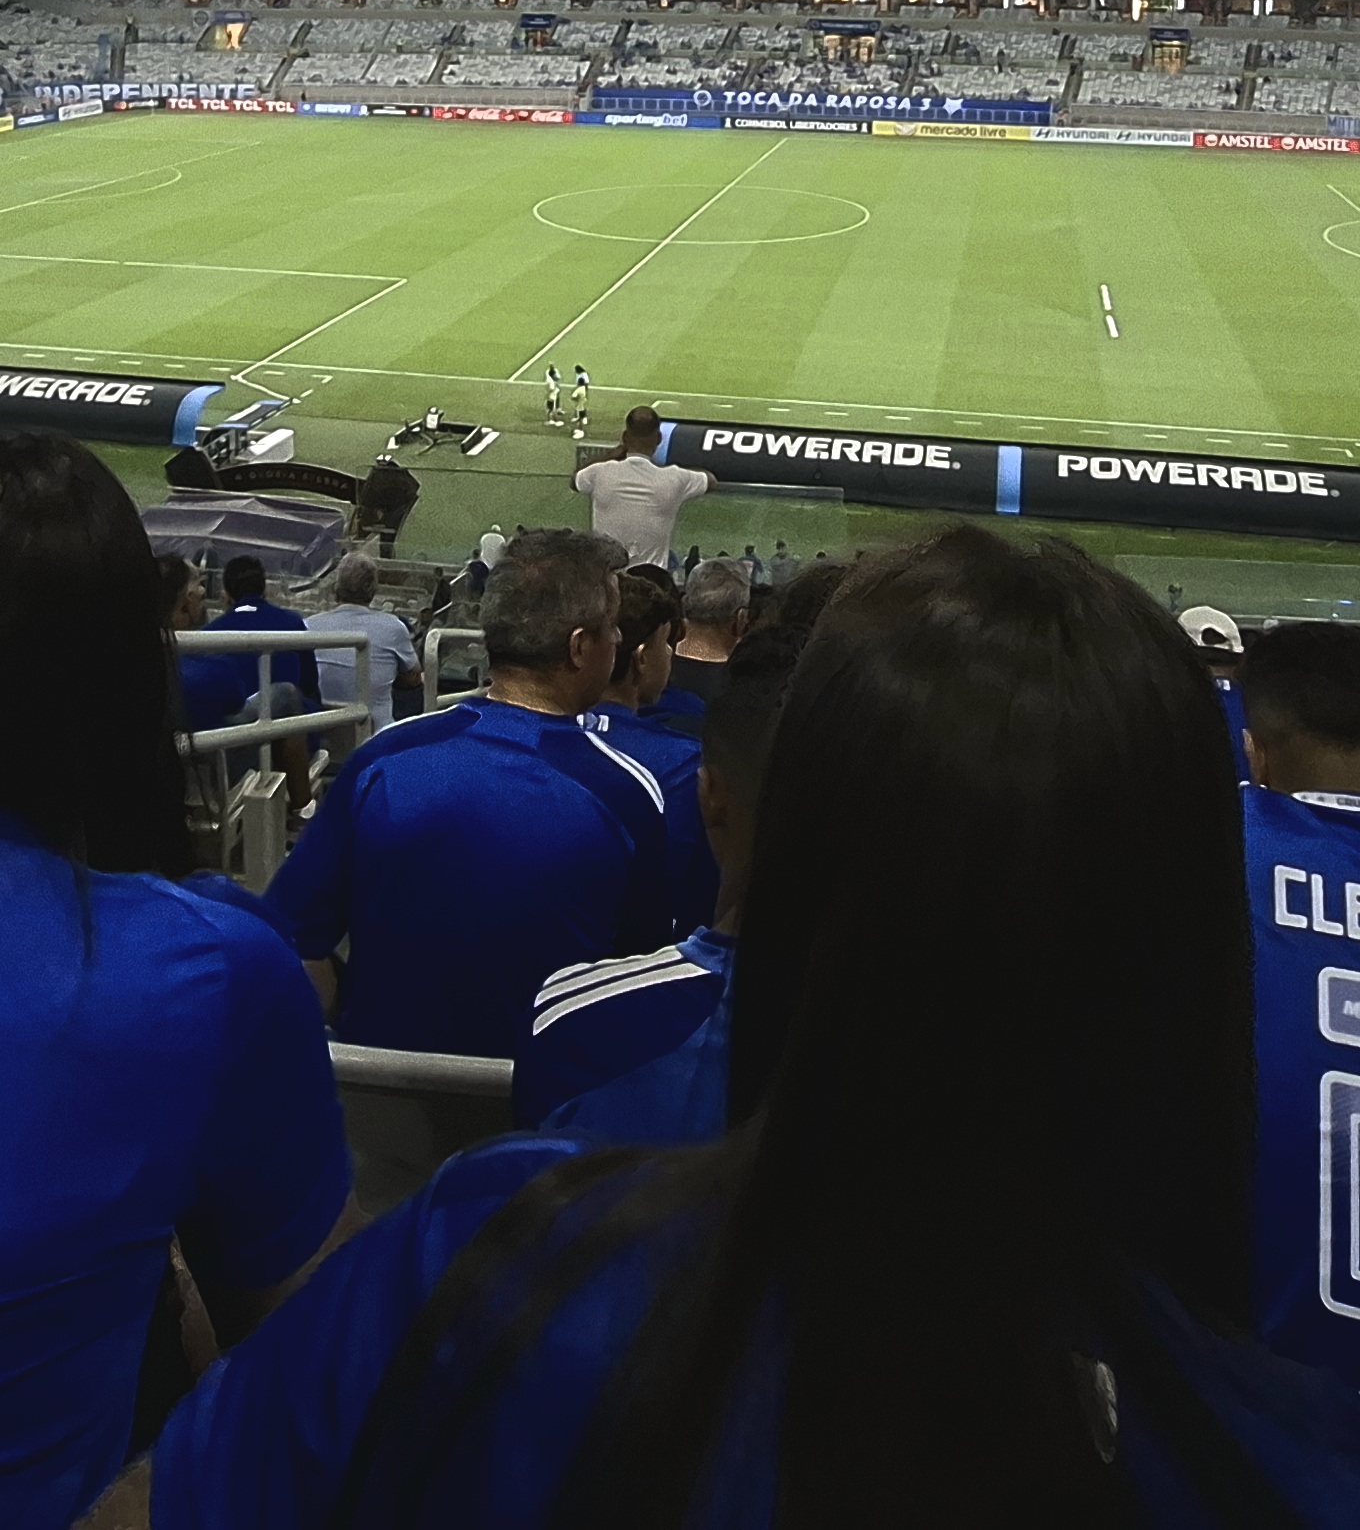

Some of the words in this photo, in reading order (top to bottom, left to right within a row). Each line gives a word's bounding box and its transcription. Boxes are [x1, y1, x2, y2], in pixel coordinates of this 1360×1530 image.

[168, 98, 197, 110] TCL
[201, 100, 230, 111] TCL
[233, 100, 263, 112] TCL
[266, 101, 296, 113] TCL
[722, 91, 781, 106] TOCA
[789, 93, 818, 107] DA
[826, 94, 912, 110] RAPOSA
[920, 97, 932, 111] 3
[604, 113, 688, 128] sportingbet
[920, 124, 976, 138] mercado
[979, 126, 1007, 139] livre
[1055, 129, 1110, 141] HYUNDAI
[1217, 134, 1274, 149] AMSTEL
[1294, 137, 1352, 153] AMSTEL
[702, 429, 951, 468] POWERADE
[1058, 454, 1330, 496] POWERADE
